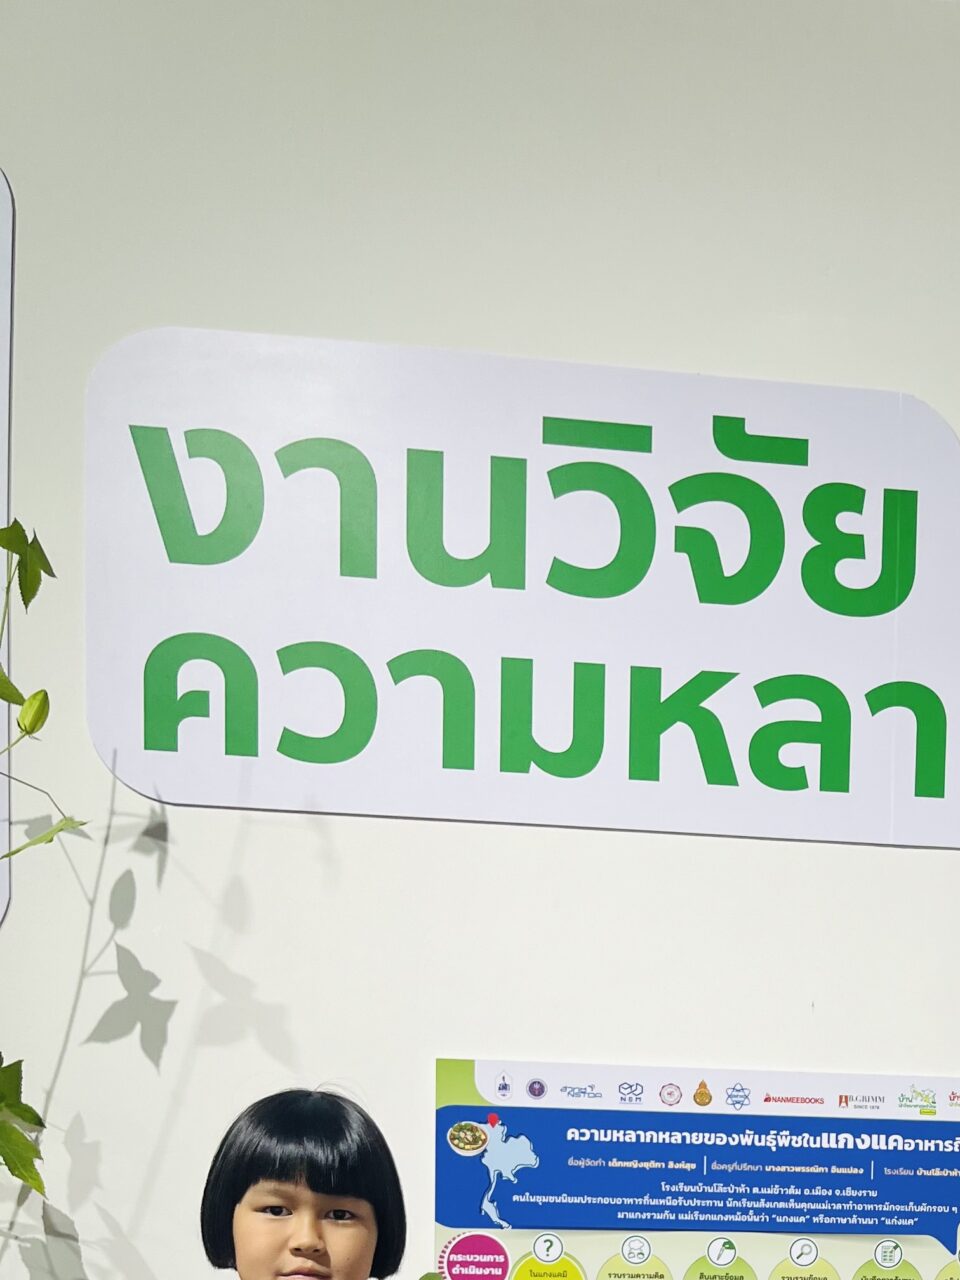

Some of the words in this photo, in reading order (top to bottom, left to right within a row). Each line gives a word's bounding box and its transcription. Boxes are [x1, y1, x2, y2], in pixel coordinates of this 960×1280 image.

[128, 415, 919, 617] งานวิจัย
[771, 1096, 825, 1105] NANMEEBOOKS
